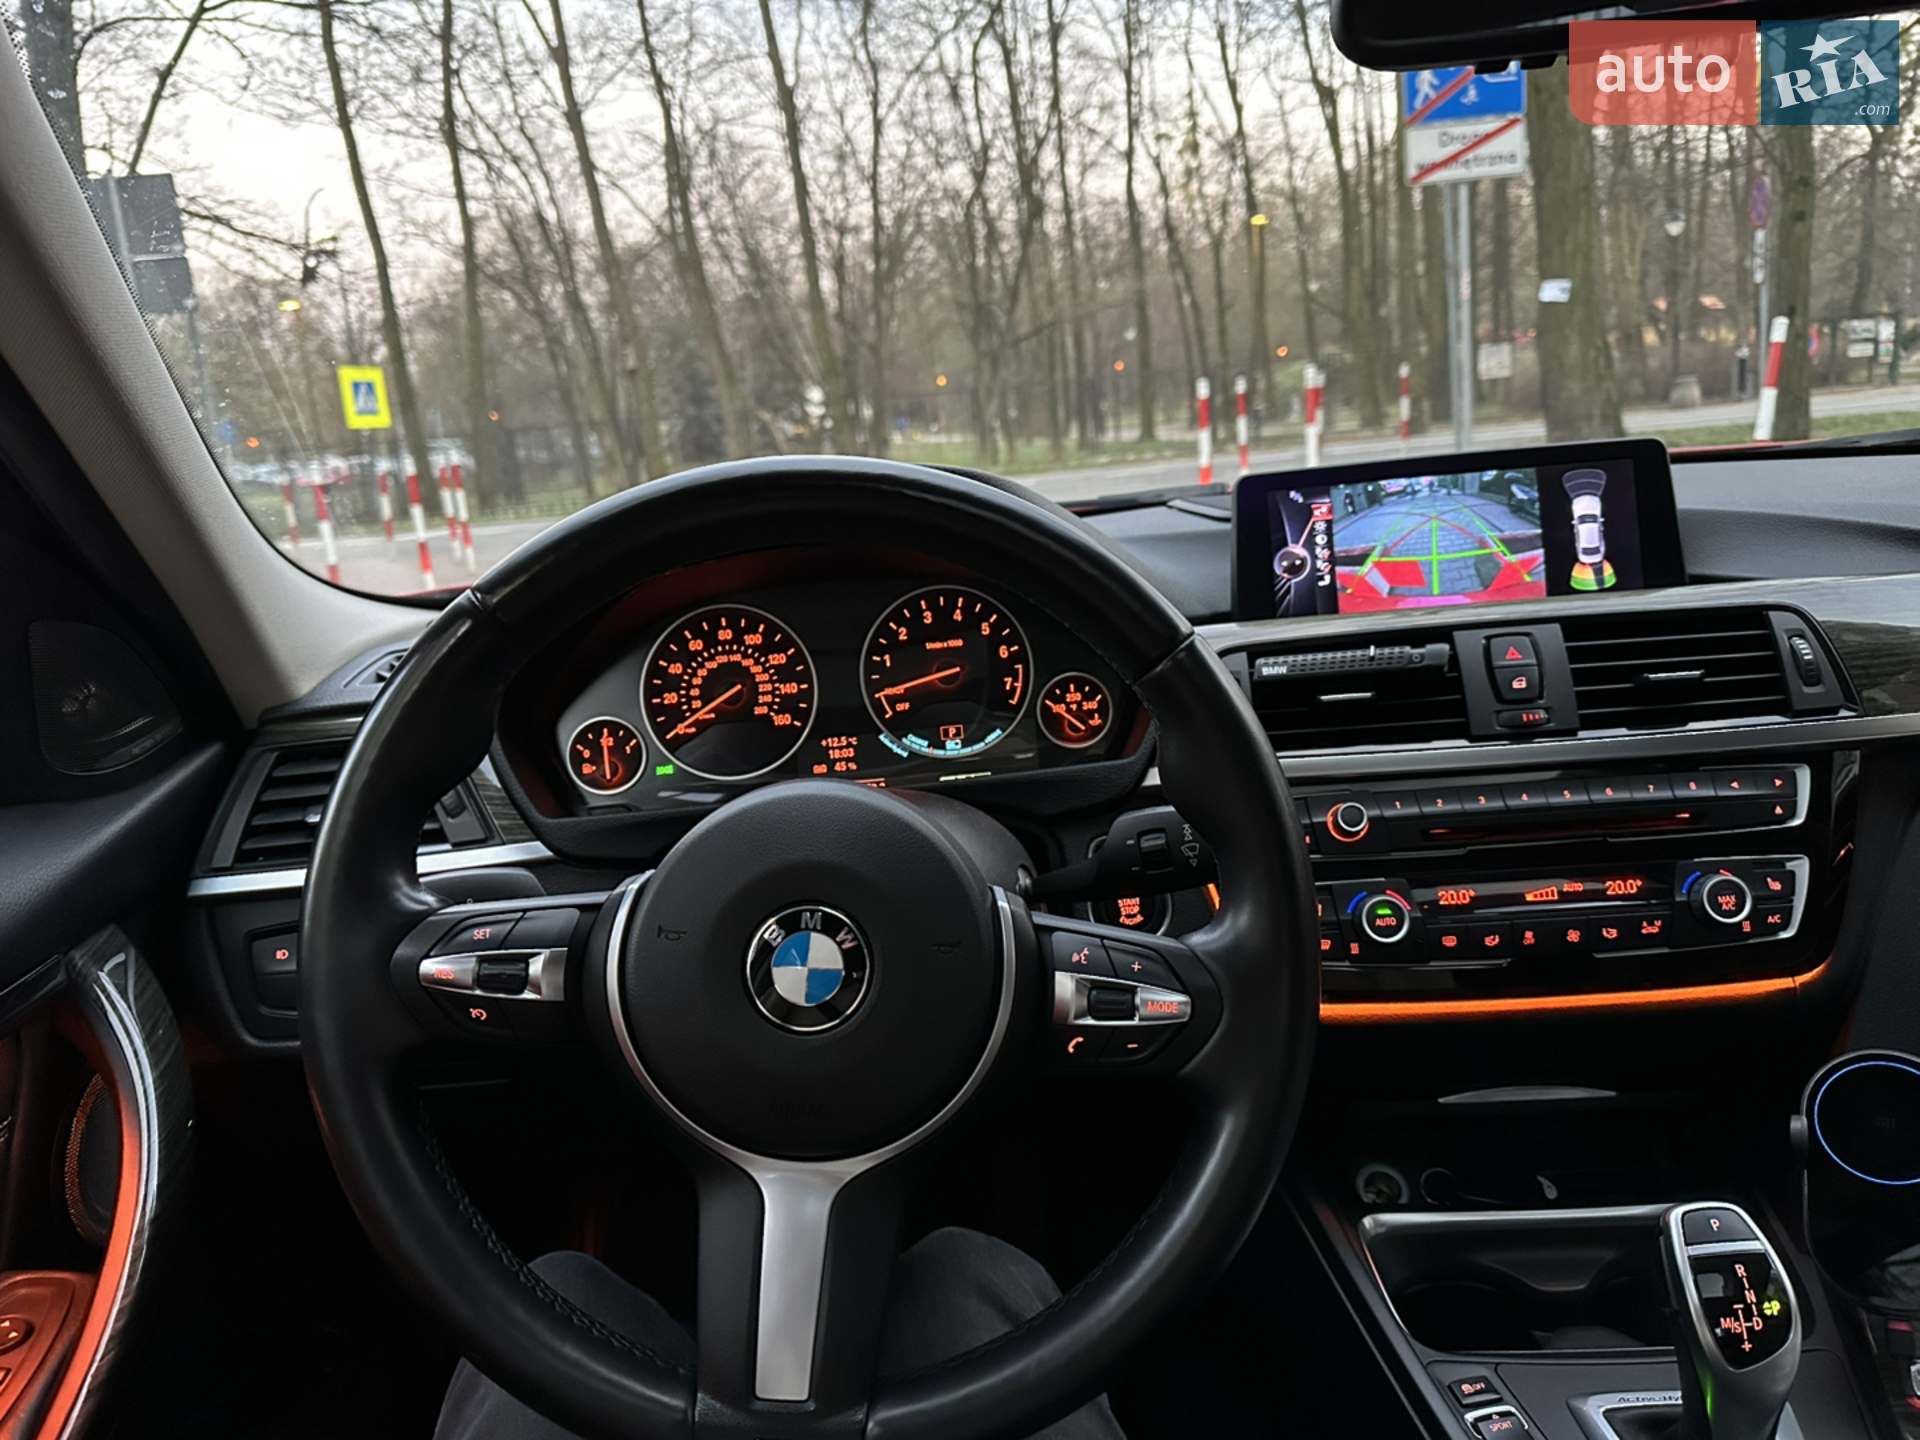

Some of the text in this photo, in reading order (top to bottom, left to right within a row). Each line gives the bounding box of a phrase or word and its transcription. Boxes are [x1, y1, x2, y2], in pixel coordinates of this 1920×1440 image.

[923, 611, 932, 624] 3
[953, 609, 962, 621] 4
[718, 629, 733, 640] 80
[898, 627, 908, 640] 2
[981, 622, 990, 635] 5
[688, 639, 703, 651] 60
[743, 634, 762, 645] 100
[999, 645, 1008, 658] 6
[768, 653, 787, 665] 120
[883, 654, 891, 667] 1
[668, 663, 683, 674] 40
[1262, 665, 1288, 676] BMW
[779, 682, 798, 694] 140
[1004, 677, 1013, 690] 7
[663, 692, 678, 704] 20
[773, 714, 792, 726] 160
[949, 727, 957, 738] P
[828, 747, 855, 759] 18:03
[1605, 787, 1613, 796] 6
[1647, 784, 1654, 793] 7
[1689, 781, 1697, 791] 8
[1478, 795, 1486, 805] 3
[1521, 793, 1528, 802] 4
[1563, 789, 1571, 799] 5
[1395, 800, 1401, 809] 1
[1436, 798, 1444, 808] 2
[1117, 897, 1140, 907] START
[1717, 894, 1736, 904] MAX
[1120, 905, 1140, 915] STOP
[1375, 918, 1397, 927] AUTO
[1767, 914, 1781, 923] A/C
[473, 928, 491, 940] SET
[763, 911, 859, 950] BMW
[434, 967, 455, 979] RES
[1147, 1001, 1179, 1013] MODE
[1710, 1218, 1720, 1232] P
[1734, 1264, 1747, 1277] R
[1744, 1289, 1756, 1304] N
[1753, 1316, 1763, 1331] D
[1489, 1420, 1513, 1432] SPORT
